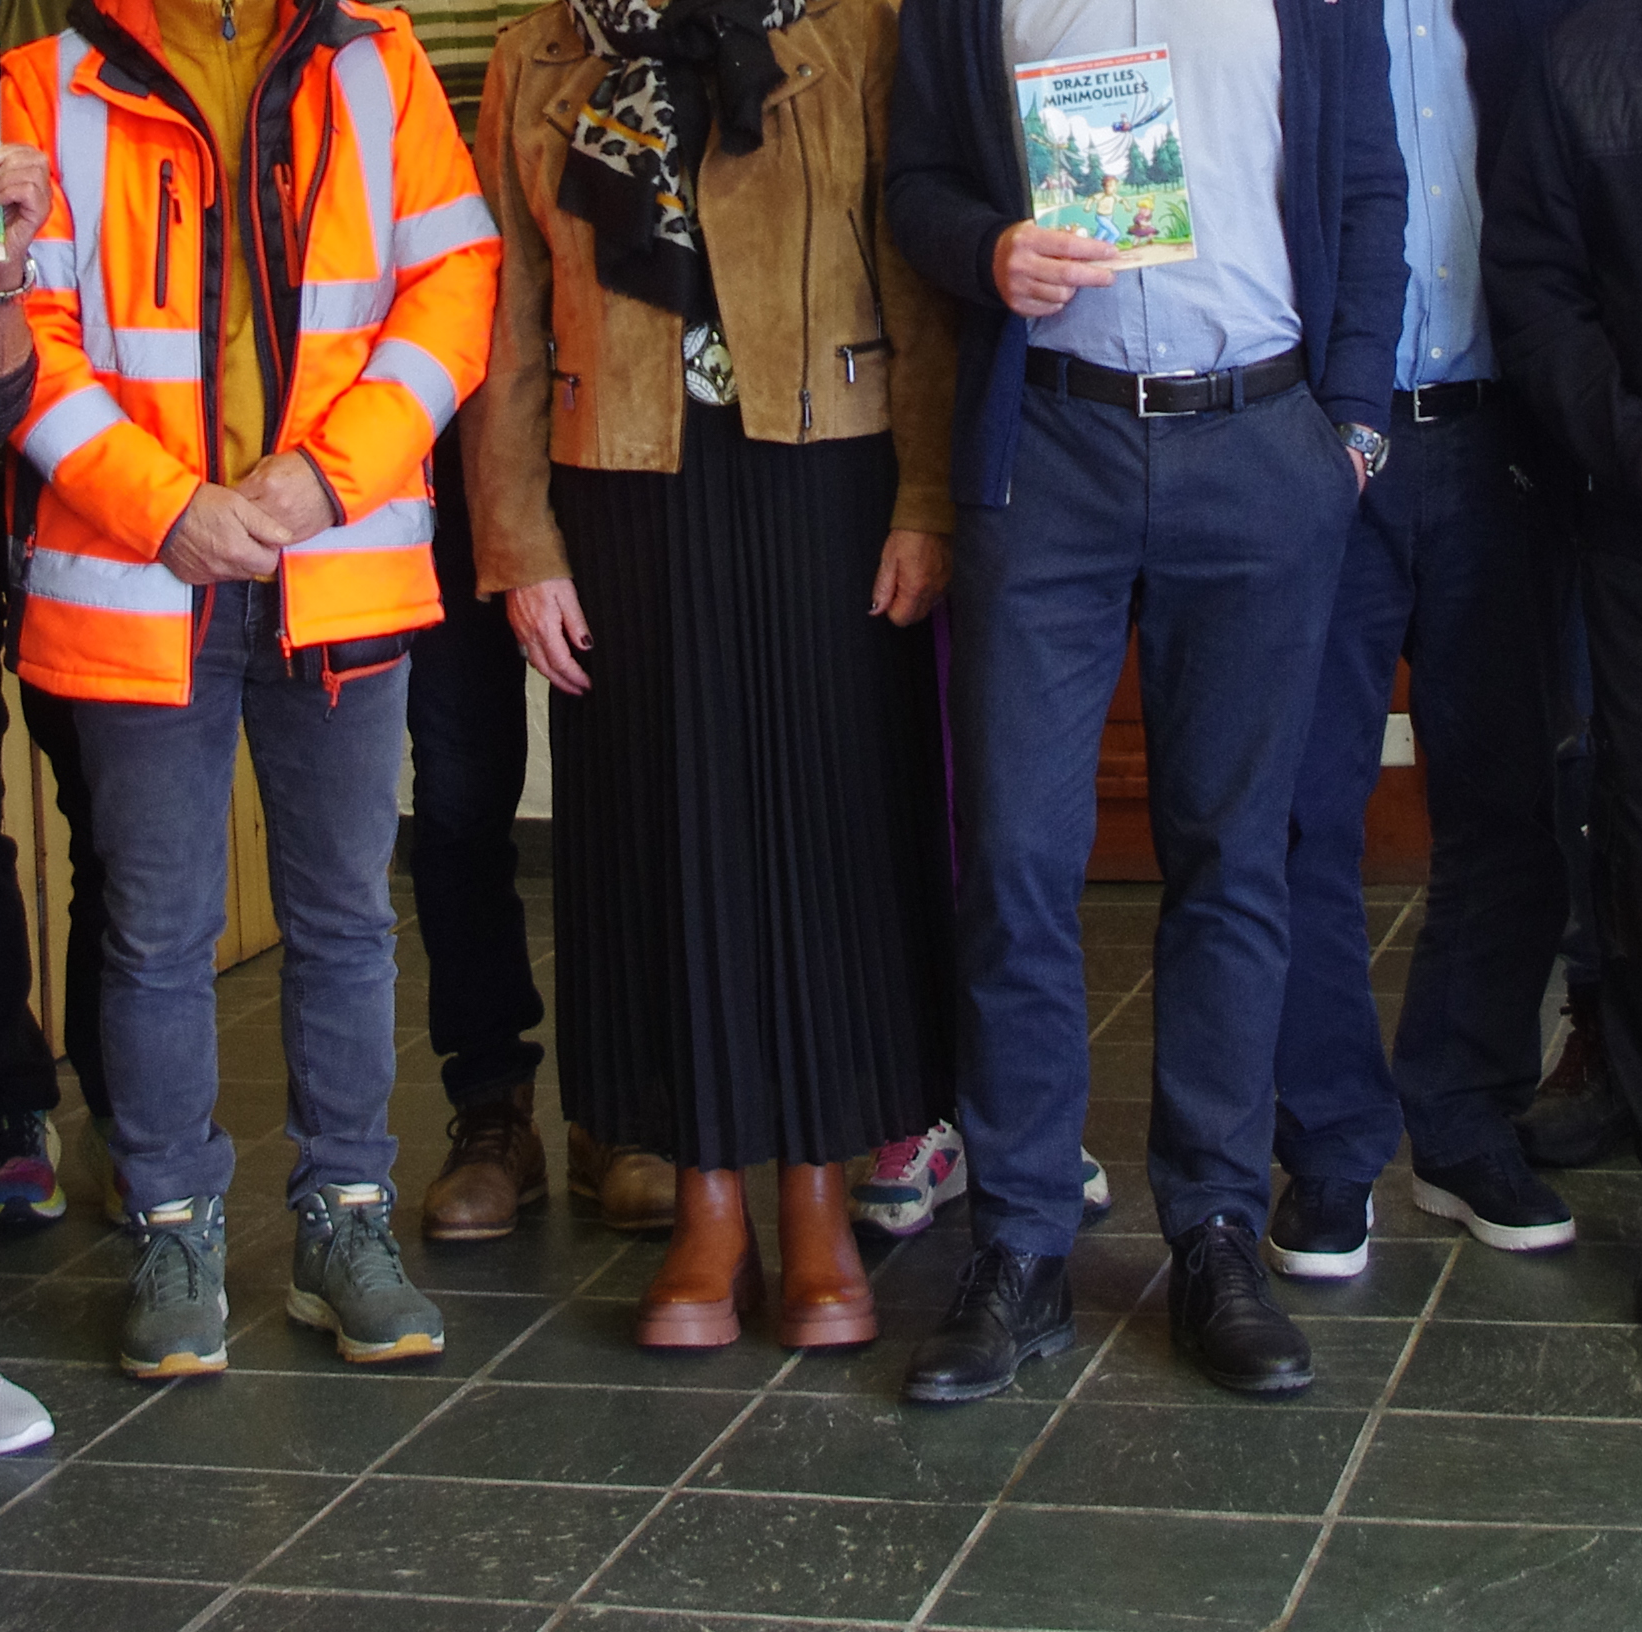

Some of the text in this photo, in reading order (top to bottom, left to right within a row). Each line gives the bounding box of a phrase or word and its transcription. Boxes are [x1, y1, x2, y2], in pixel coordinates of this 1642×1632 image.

[1052, 69, 1134, 91] DRAZ ET LES
[1043, 81, 1149, 107] MINIMOUILLES
